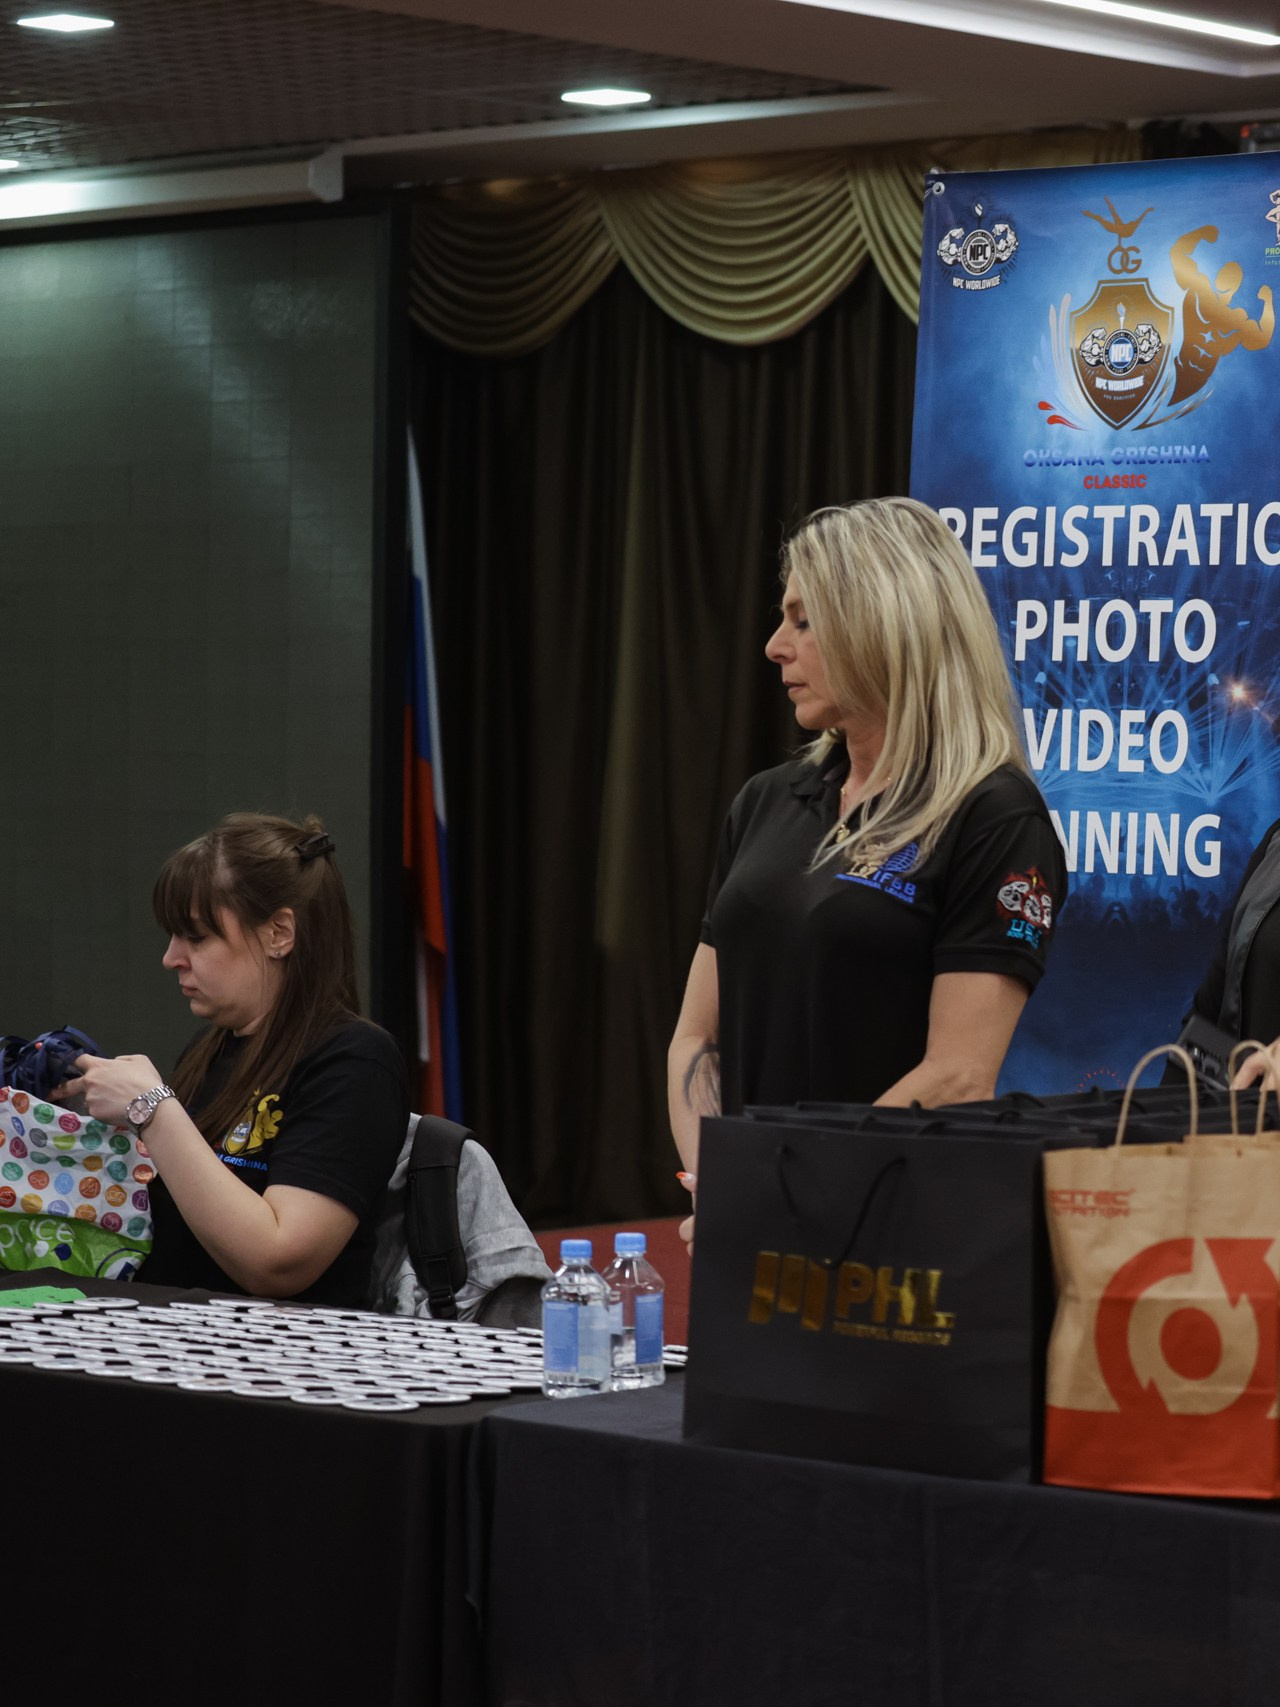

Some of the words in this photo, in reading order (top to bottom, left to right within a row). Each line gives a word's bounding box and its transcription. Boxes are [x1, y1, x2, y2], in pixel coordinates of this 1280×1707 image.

[969, 244, 988, 261] NPC
[952, 276, 965, 289] NPC
[965, 275, 1001, 290] WORLDWIDE
[1111, 343, 1133, 363] NPC
[1095, 376, 1108, 391] NPC
[1108, 375, 1145, 392] WORLDWIDE
[1023, 448, 1105, 467] OKSANA
[1110, 444, 1211, 465] GRISHINA
[1083, 474, 1147, 489] CLASSIC
[1014, 598, 1217, 664] PHOTO
[1021, 707, 1189, 774] VIDEO
[1048, 809, 1222, 878] NNING
[872, 870, 917, 897] IFBB
[223, 1155, 268, 1172] GRISHINA
